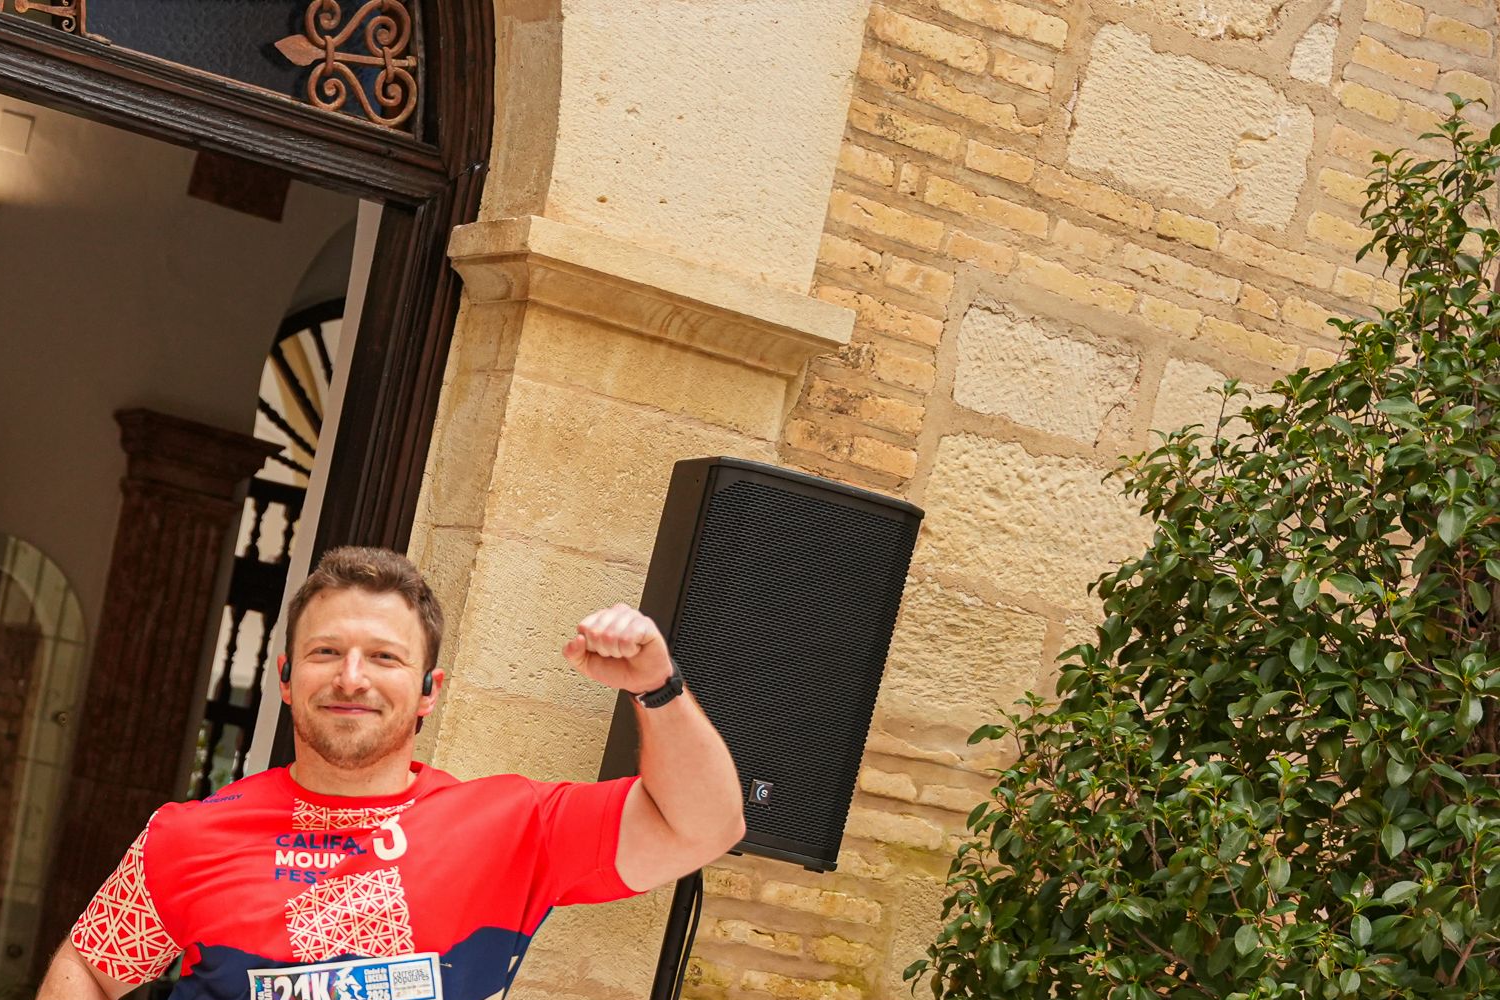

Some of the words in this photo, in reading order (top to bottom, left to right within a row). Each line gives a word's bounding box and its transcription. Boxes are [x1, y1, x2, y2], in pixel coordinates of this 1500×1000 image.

[275, 850, 346, 869] MOUN
[393, 968, 424, 978] carreras
[393, 973, 430, 985] populares
